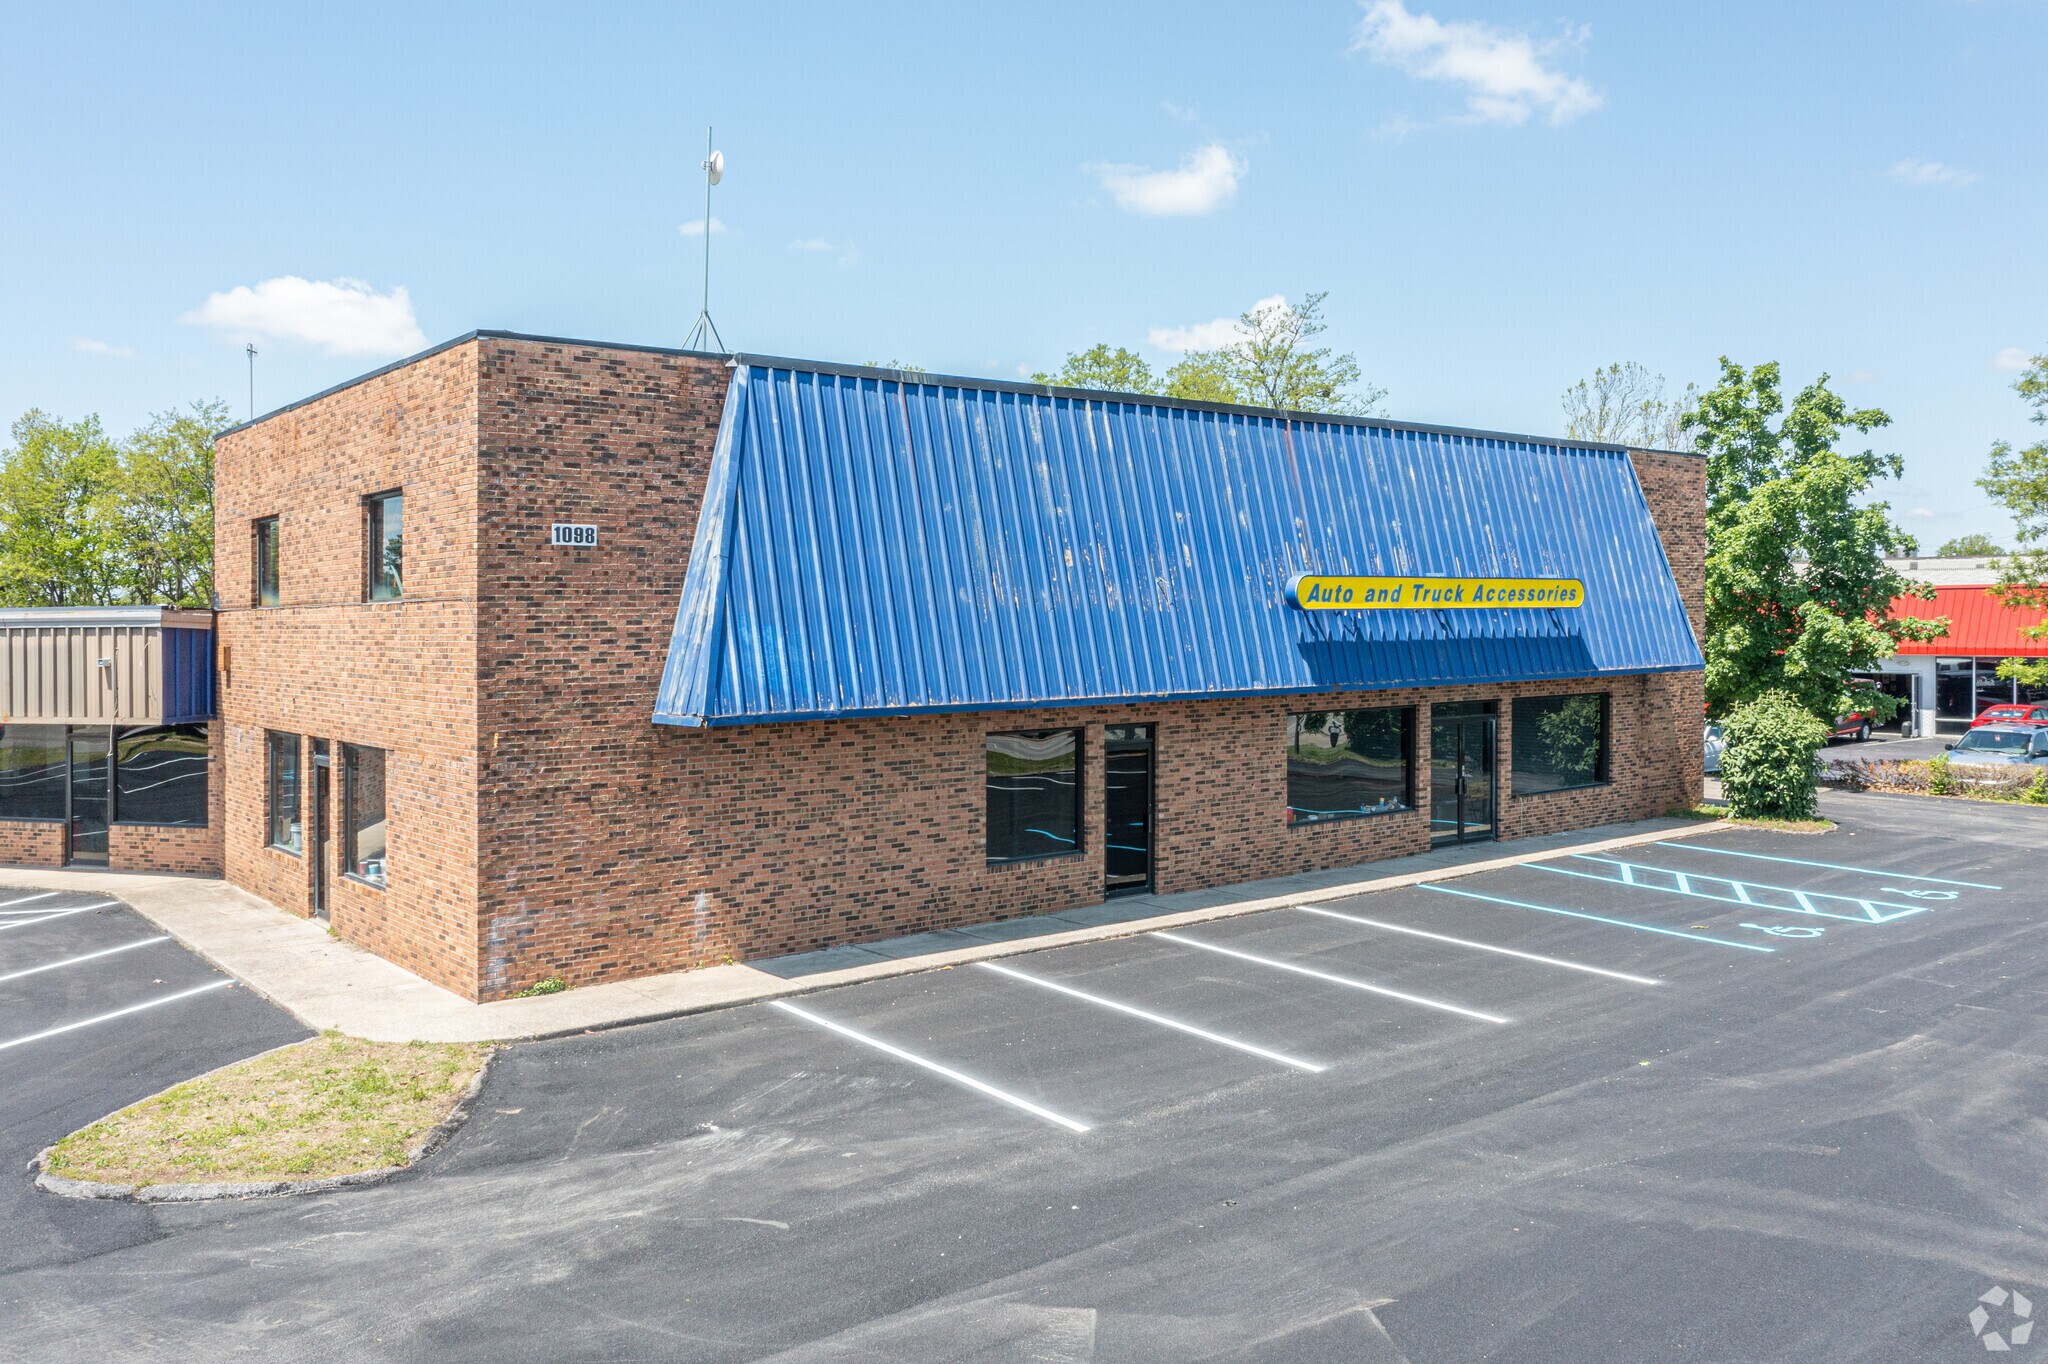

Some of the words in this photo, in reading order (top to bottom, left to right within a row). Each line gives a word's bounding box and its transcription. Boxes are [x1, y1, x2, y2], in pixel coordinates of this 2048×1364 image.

[554, 526, 595, 544] 1098
[1306, 583, 1353, 603] Auto
[1364, 584, 1403, 603] and
[1412, 584, 1465, 603] Truck
[1472, 584, 1577, 603] Accessories
